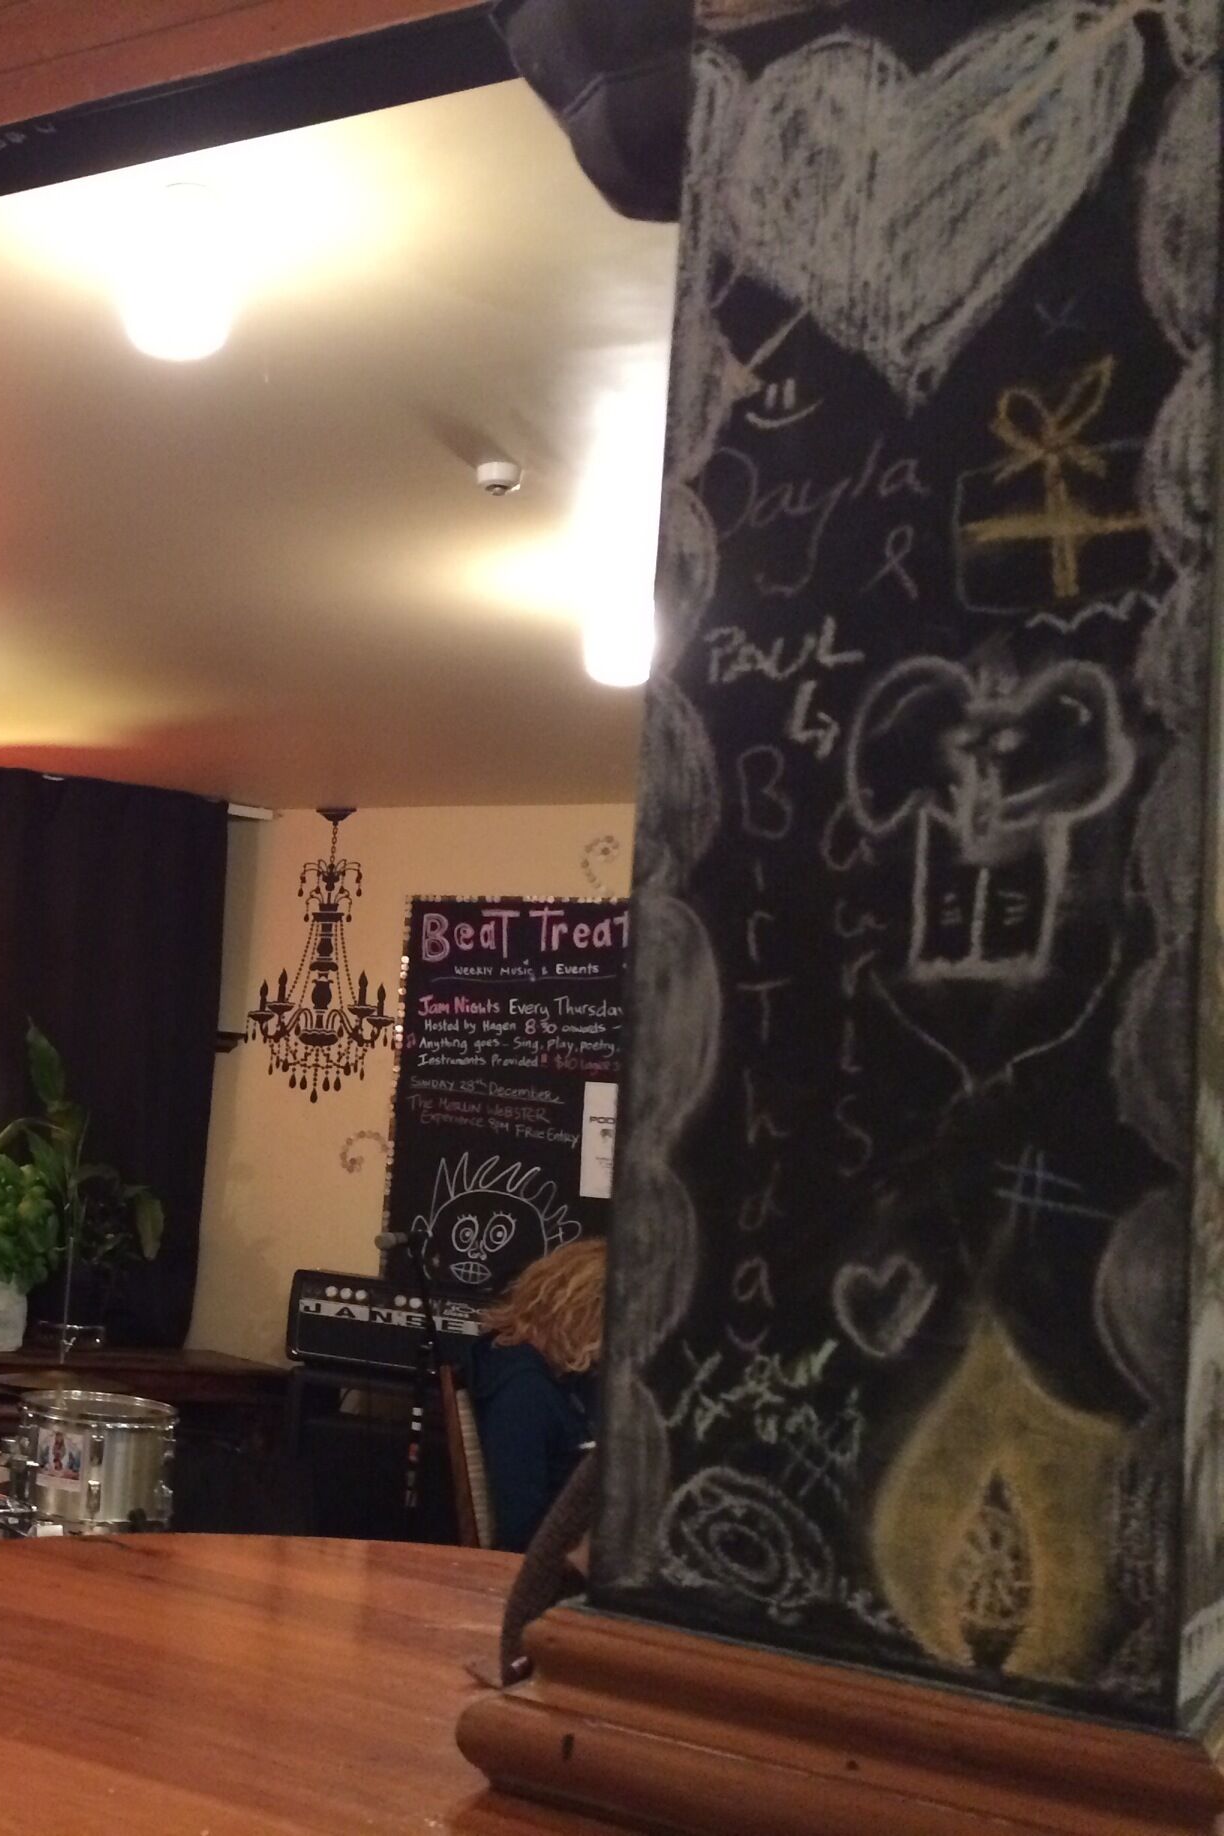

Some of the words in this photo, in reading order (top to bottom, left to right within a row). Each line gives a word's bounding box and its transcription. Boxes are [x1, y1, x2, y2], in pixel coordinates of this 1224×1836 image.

[555, 963, 600, 976] Events
[418, 995, 450, 1016] Jam
[509, 998, 551, 1021] Every
[424, 1018, 459, 1032] Hosted
[463, 1018, 476, 1034] by
[419, 1037, 468, 1055] Anything
[417, 1053, 487, 1067] Instruments
